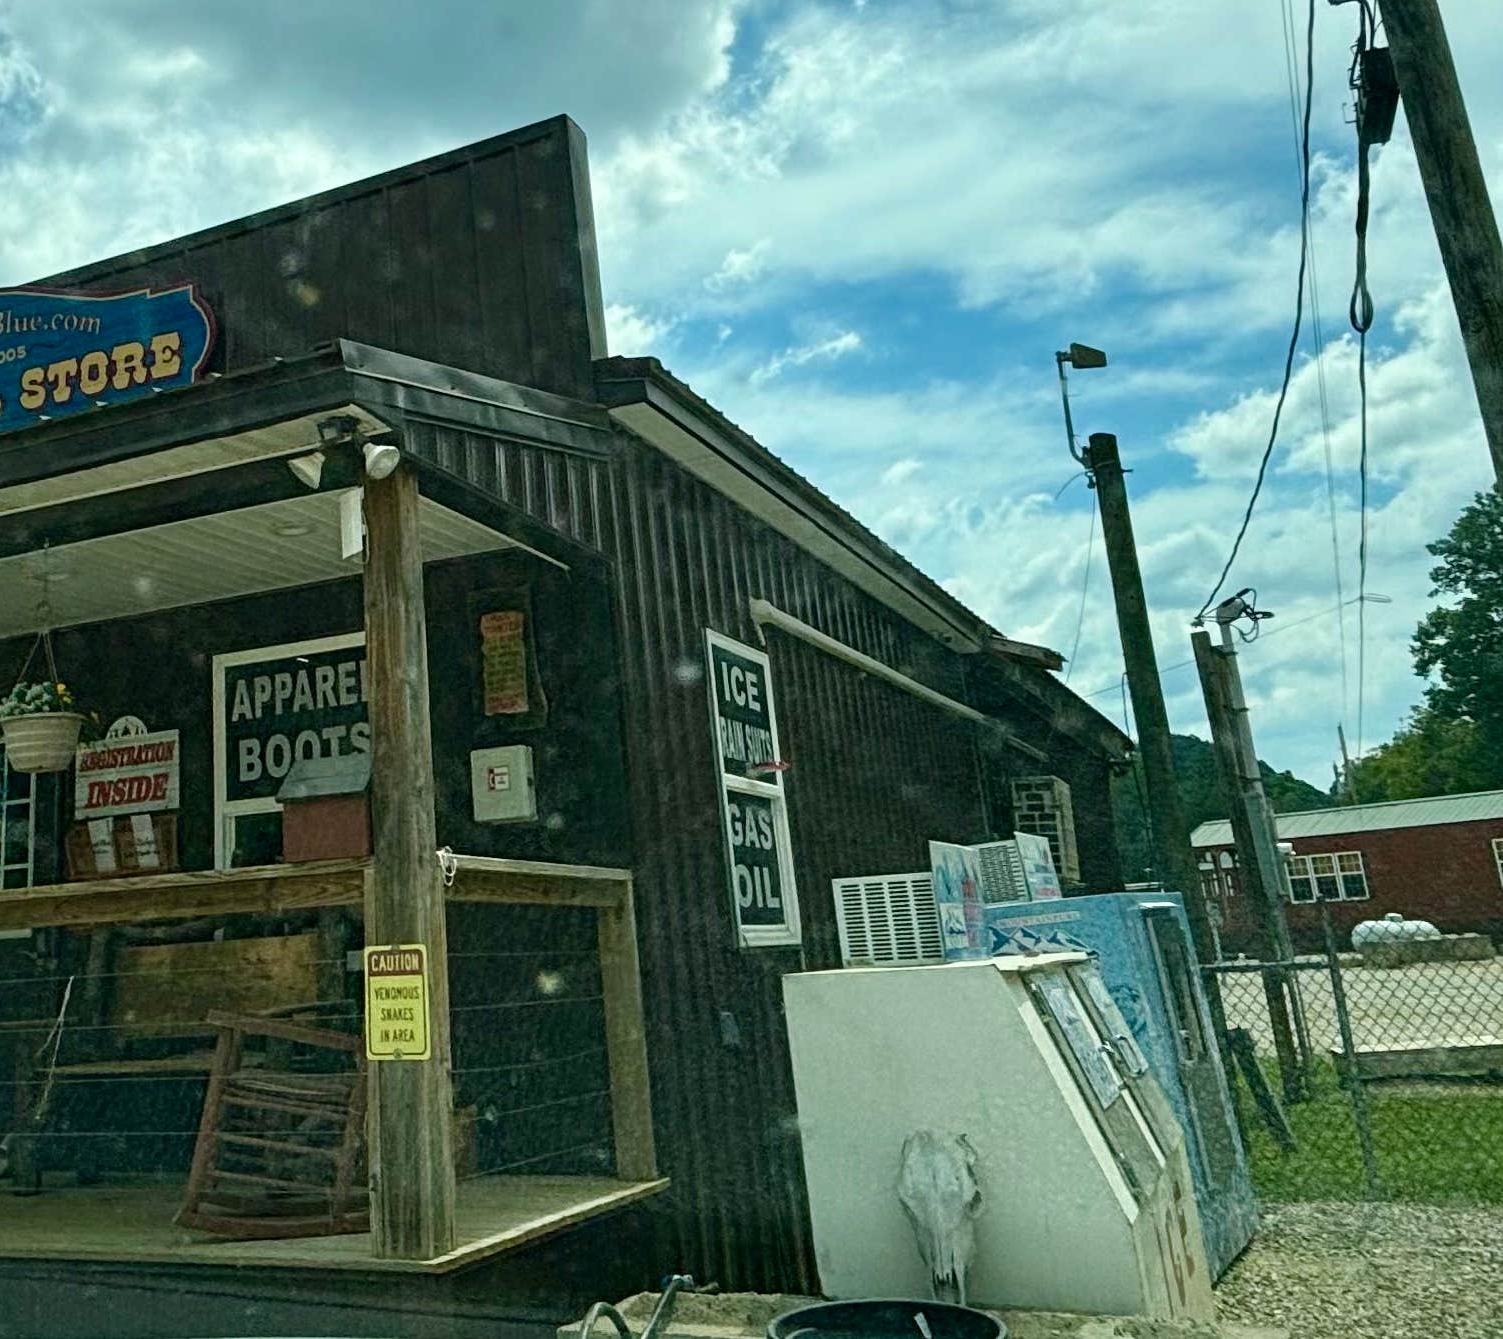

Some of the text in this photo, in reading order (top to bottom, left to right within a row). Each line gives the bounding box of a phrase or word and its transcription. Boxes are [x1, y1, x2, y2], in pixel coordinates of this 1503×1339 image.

[19, 333, 181, 410] STORE
[721, 661, 761, 712] ICE
[80, 740, 176, 773] REGISTRATION
[238, 722, 370, 782] BOOTS
[719, 716, 773, 764] RAIN SUITS
[85, 772, 170, 809] INSIDE
[727, 803, 773, 850] GAS
[734, 864, 781, 909] OIL
[371, 953, 419, 972] CAUTION
[374, 986, 419, 1000] VENOMOUS
[381, 1007, 414, 1021] SNAKES
[380, 1029, 415, 1042] IN AREA
